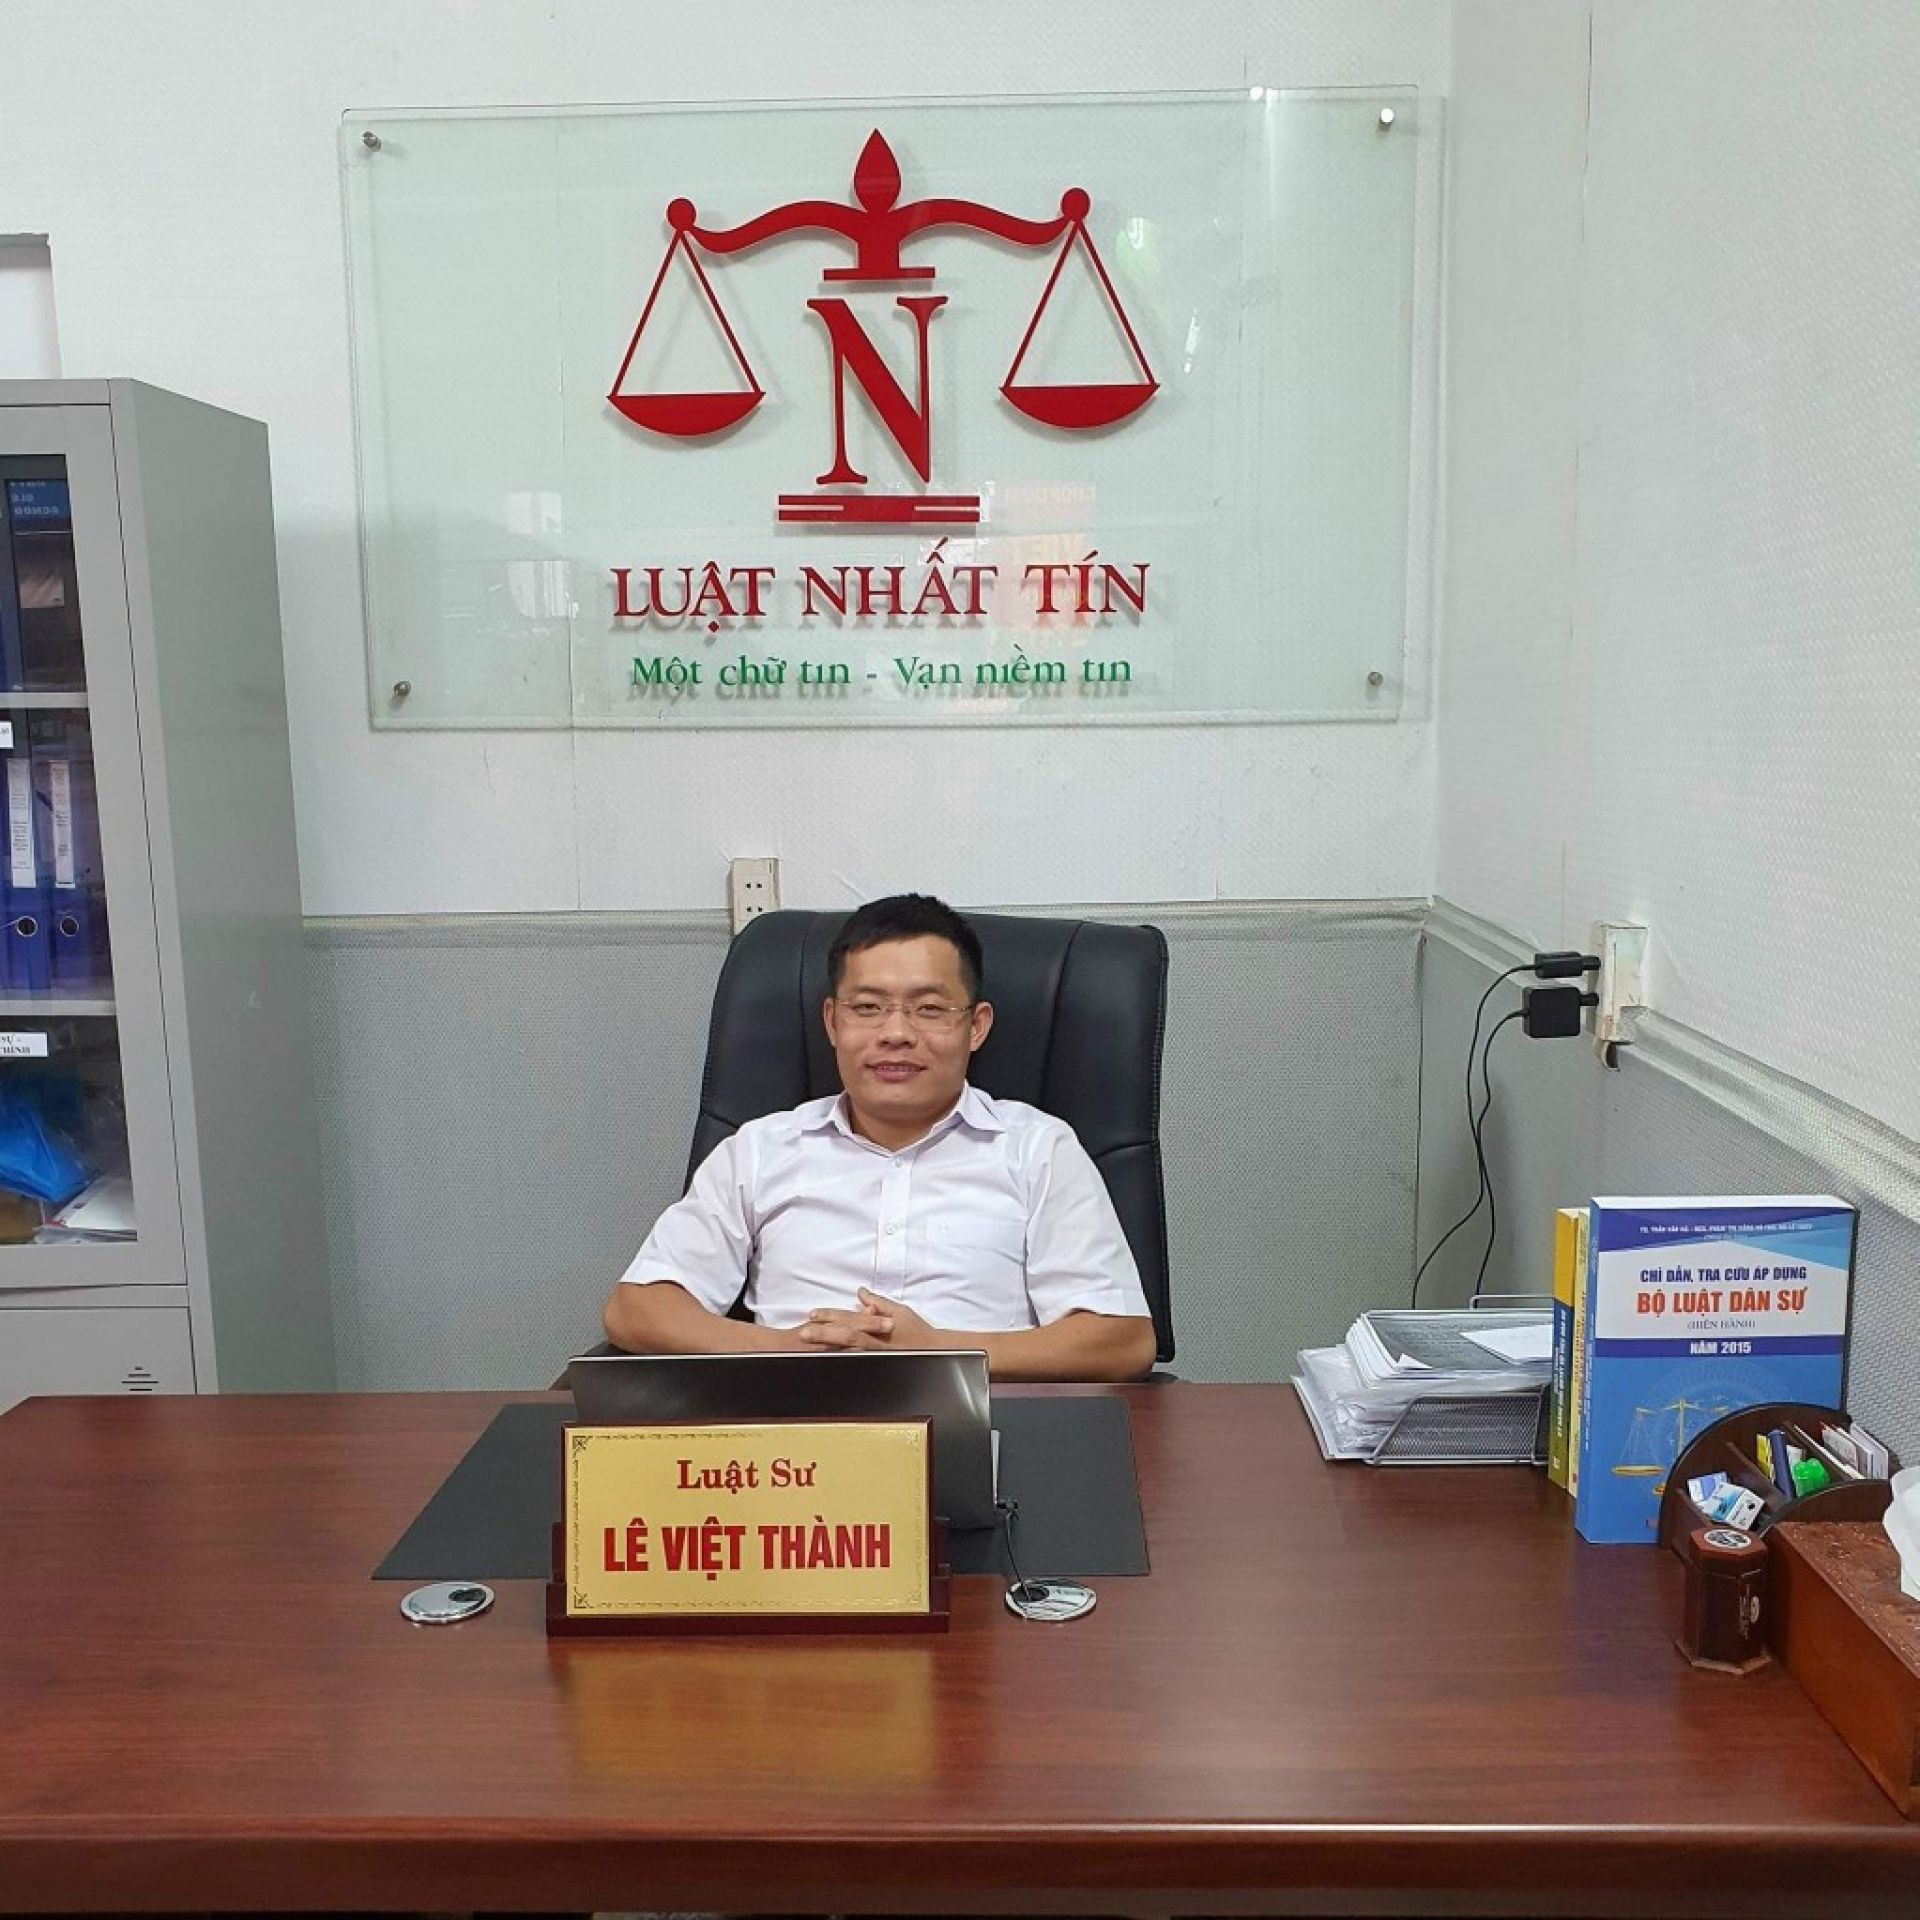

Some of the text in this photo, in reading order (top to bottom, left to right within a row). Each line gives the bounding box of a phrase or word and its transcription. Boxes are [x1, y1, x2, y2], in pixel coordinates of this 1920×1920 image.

[807, 296, 949, 484] N
[609, 537, 1151, 633] LUẬT NHẤT TÍN
[631, 657, 702, 691] Một
[718, 655, 788, 686] chữ
[893, 656, 962, 689] Vạn
[976, 643, 1066, 684] niềm
[1698, 1268, 1721, 1281] TRA
[1637, 1286, 1808, 1317] BỘ LUẬT DÂN SỰ
[1690, 1340, 1752, 1355] NĂM 2015
[676, 1458, 817, 1495] Luật Sư
[603, 1514, 891, 1581] LÊ VIỆT THÀNH
